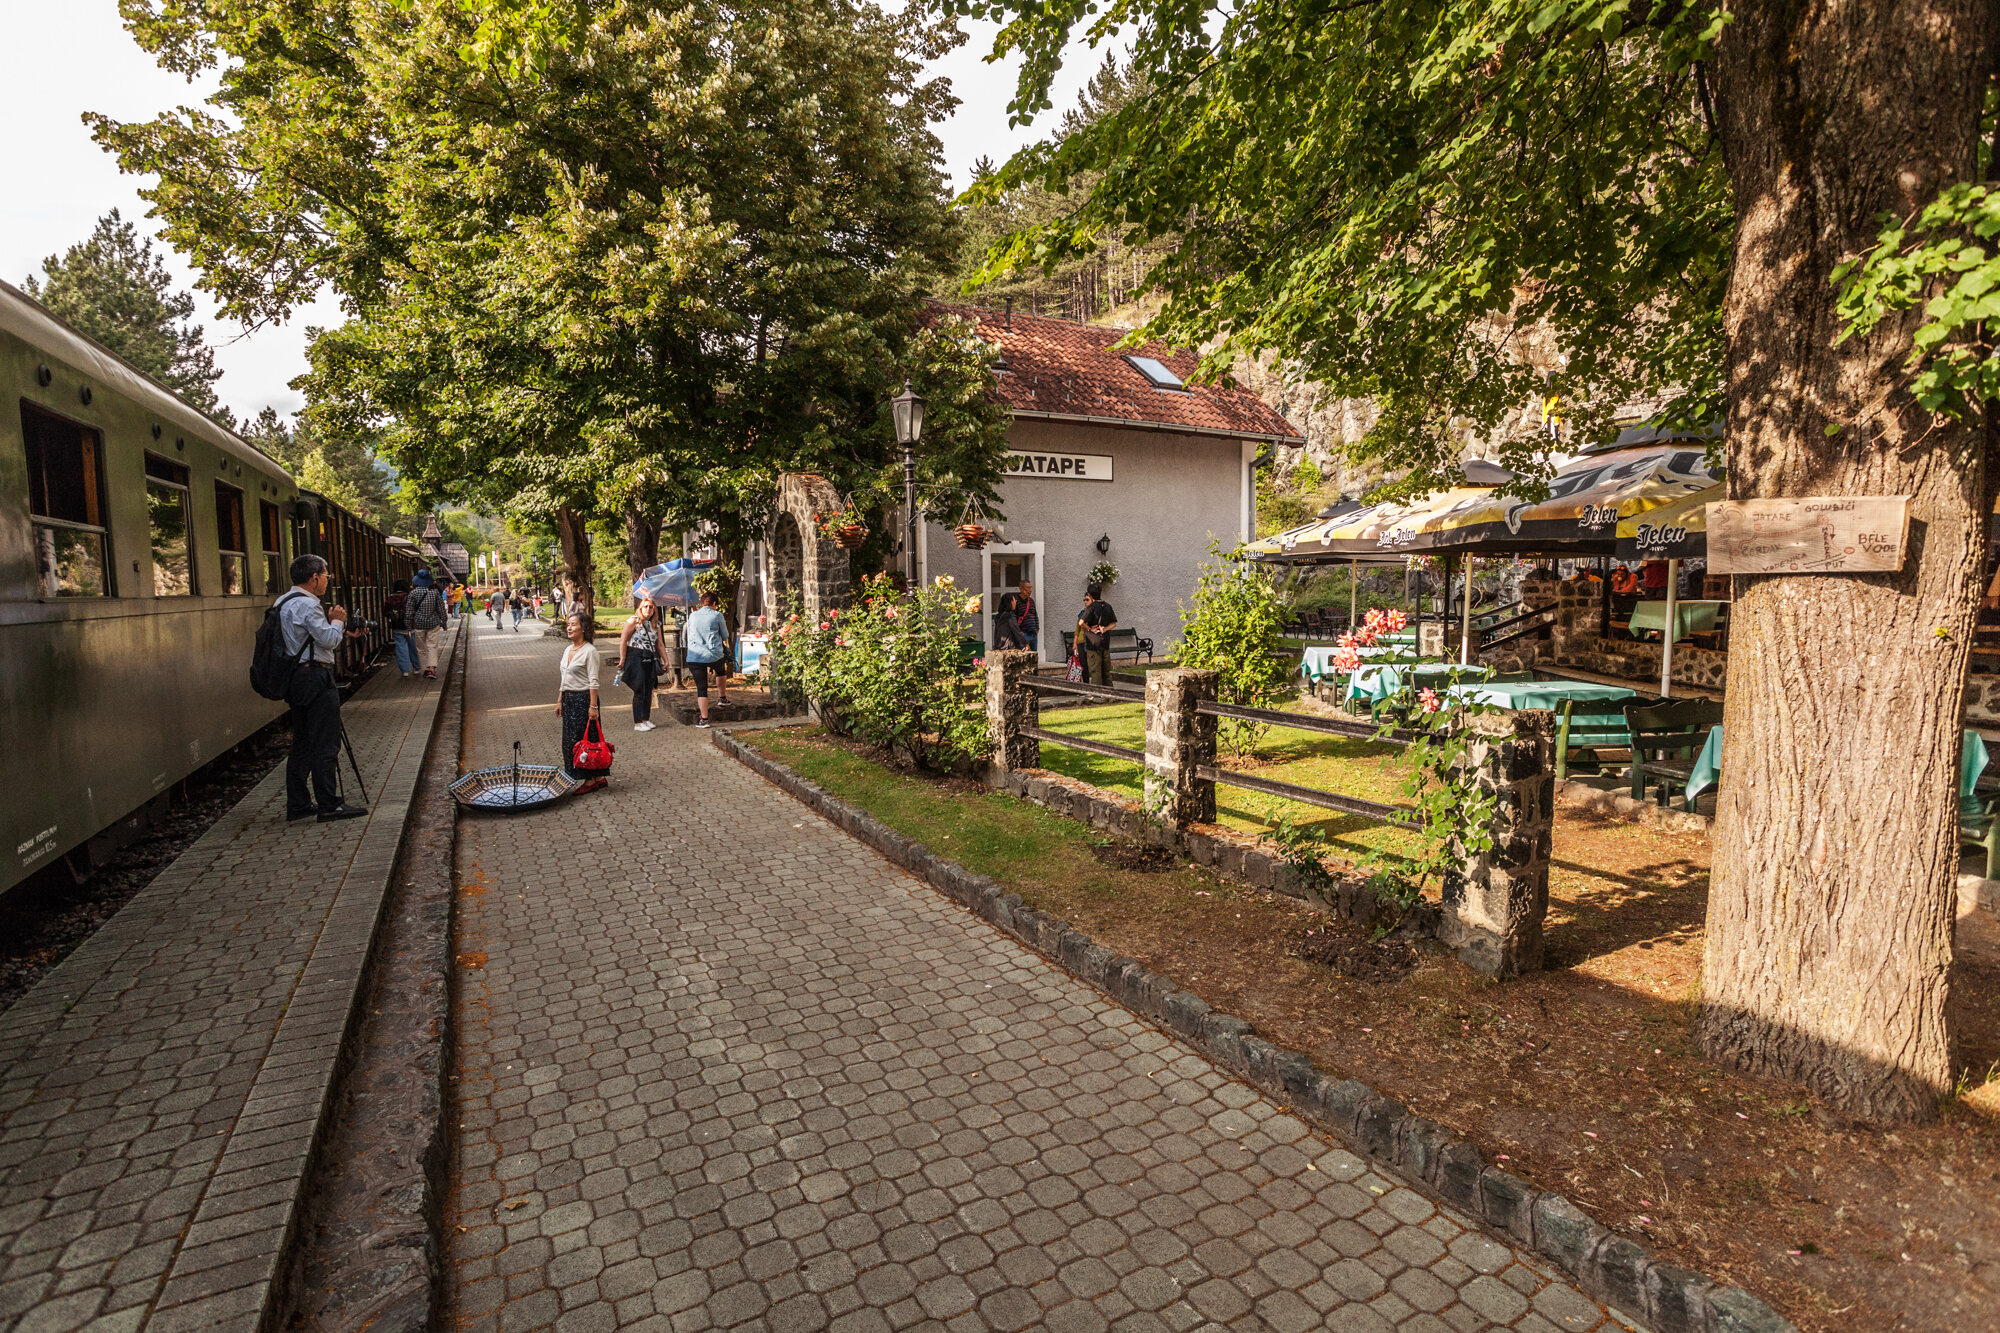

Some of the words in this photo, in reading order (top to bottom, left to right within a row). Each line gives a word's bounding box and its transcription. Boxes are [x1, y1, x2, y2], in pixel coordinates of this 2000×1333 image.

[1578, 504, 1618, 527] Jelen
[1636, 523, 1687, 549] Jelen
[1863, 544, 1897, 553] VODE
[1825, 561, 1845, 570] PUT
